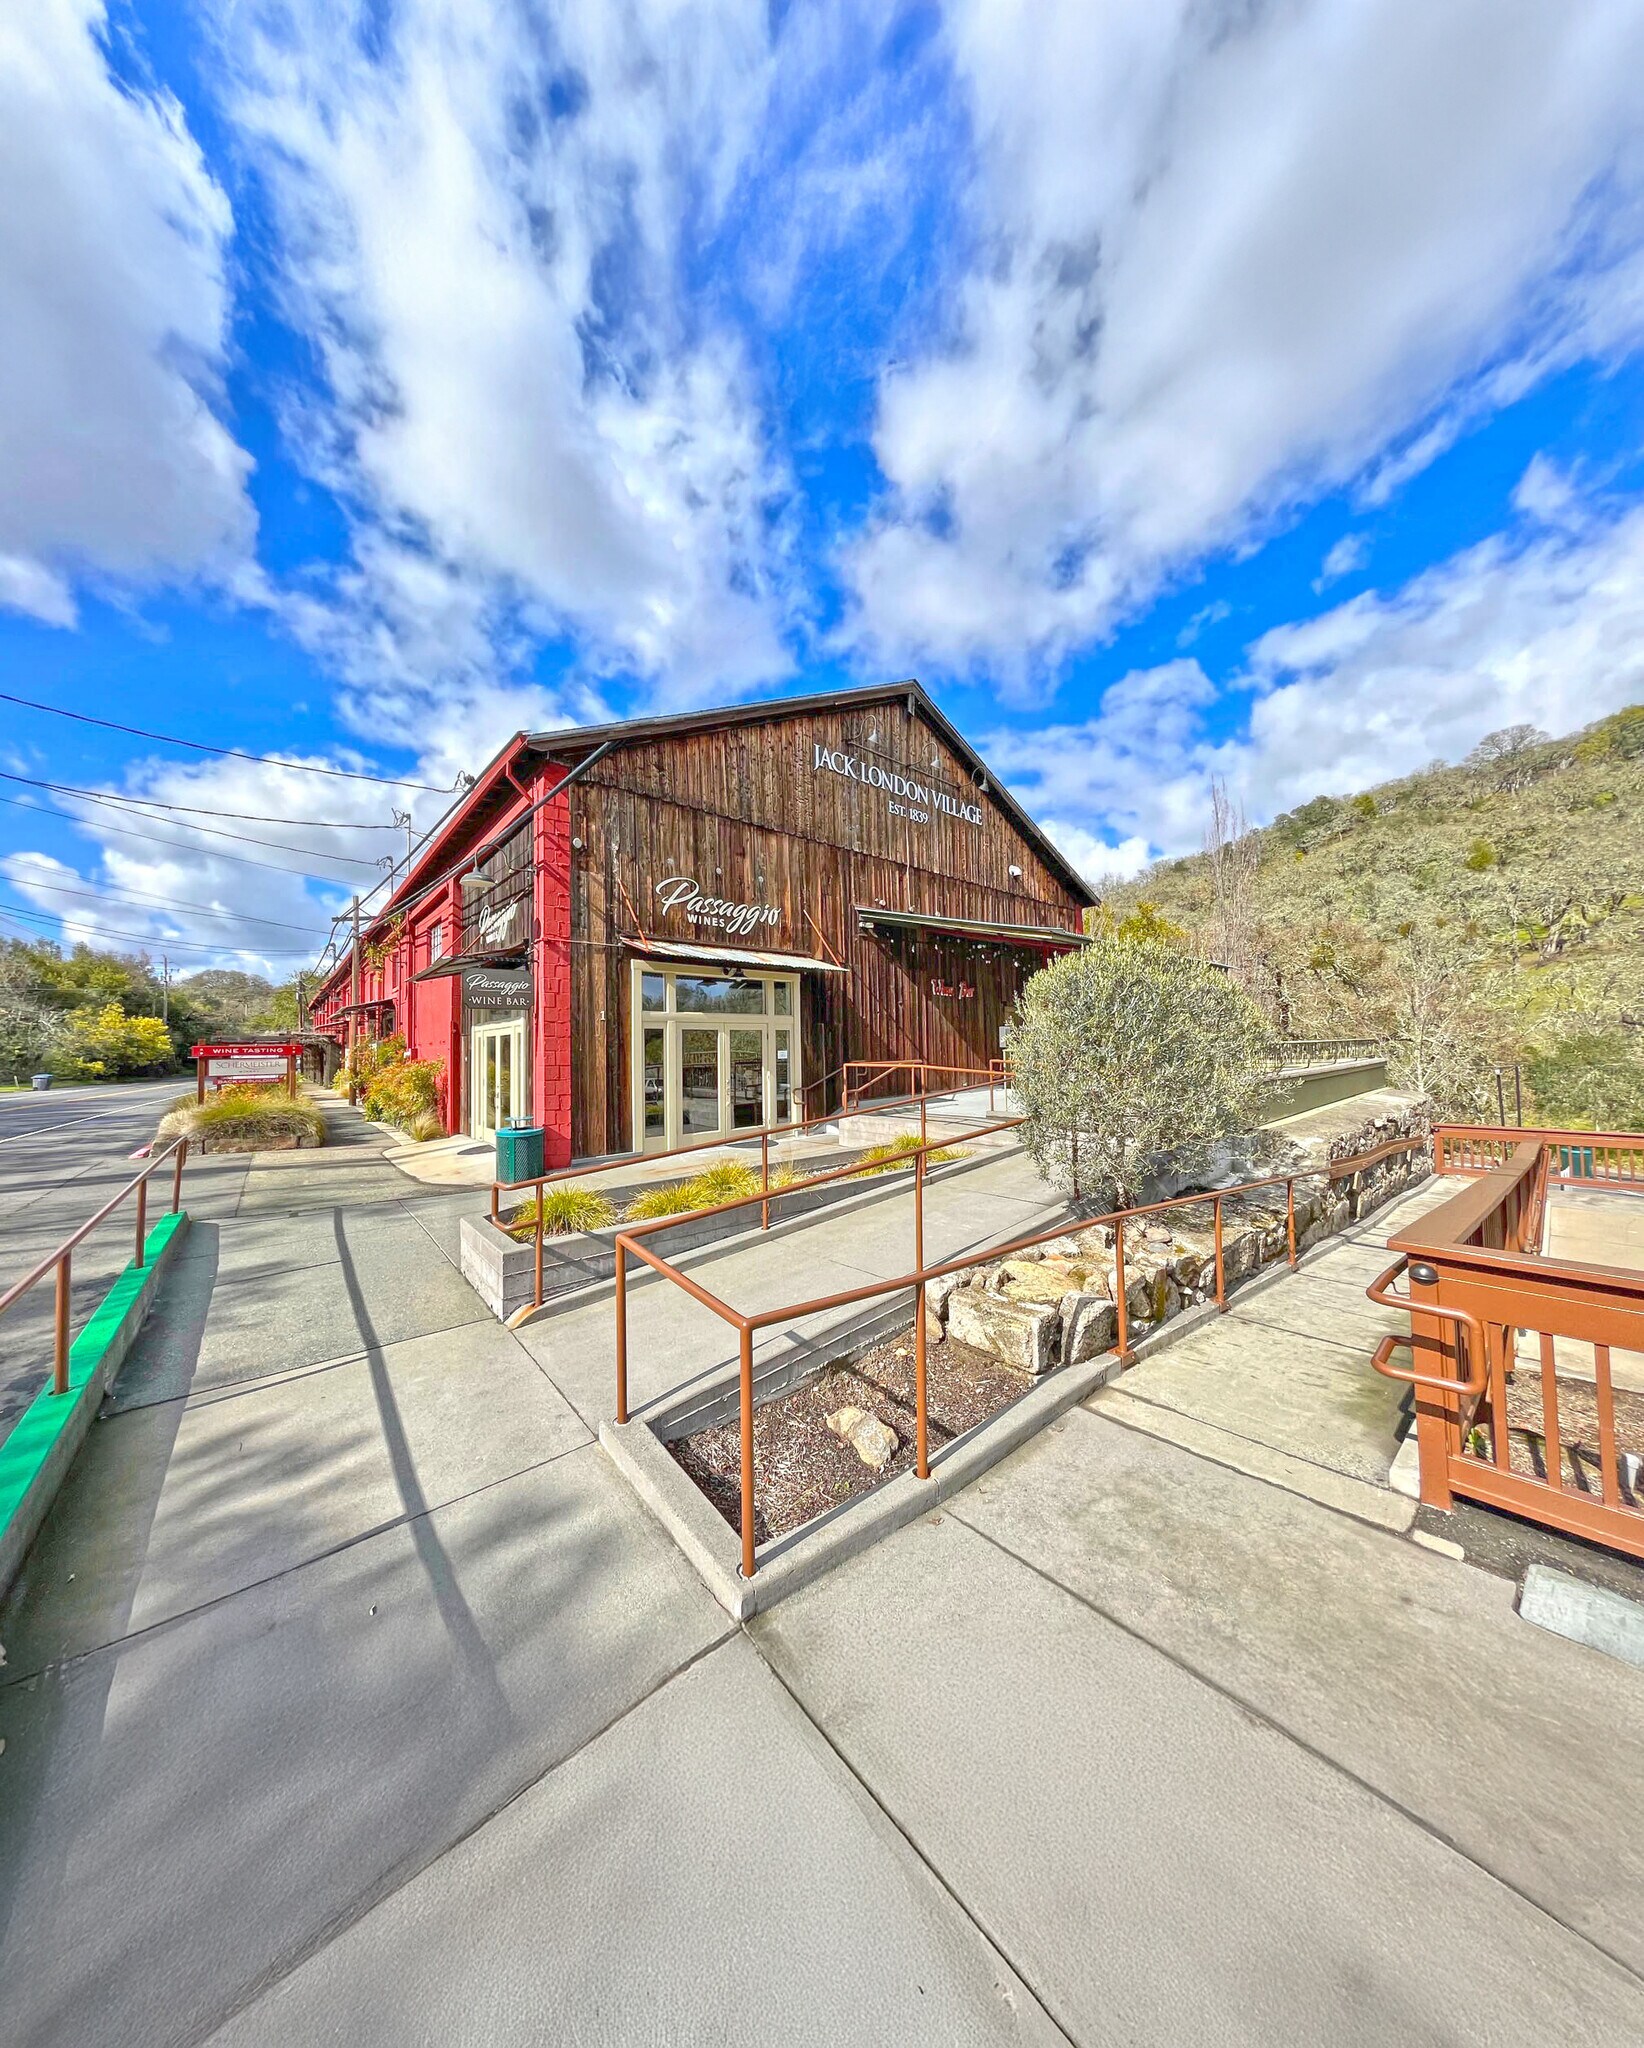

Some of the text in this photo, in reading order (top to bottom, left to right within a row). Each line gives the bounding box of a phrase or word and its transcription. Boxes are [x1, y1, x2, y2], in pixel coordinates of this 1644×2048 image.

[813, 743, 983, 826] JACK LONDON VILLAGE
[888, 800, 929, 825] EST. 1839
[655, 876, 782, 936] Passaggio
[686, 913, 726, 928] WINES
[466, 973, 529, 996] Passaggio
[471, 996, 527, 1006] WINE BAR
[215, 1061, 281, 1070] SCHERMEISTER
